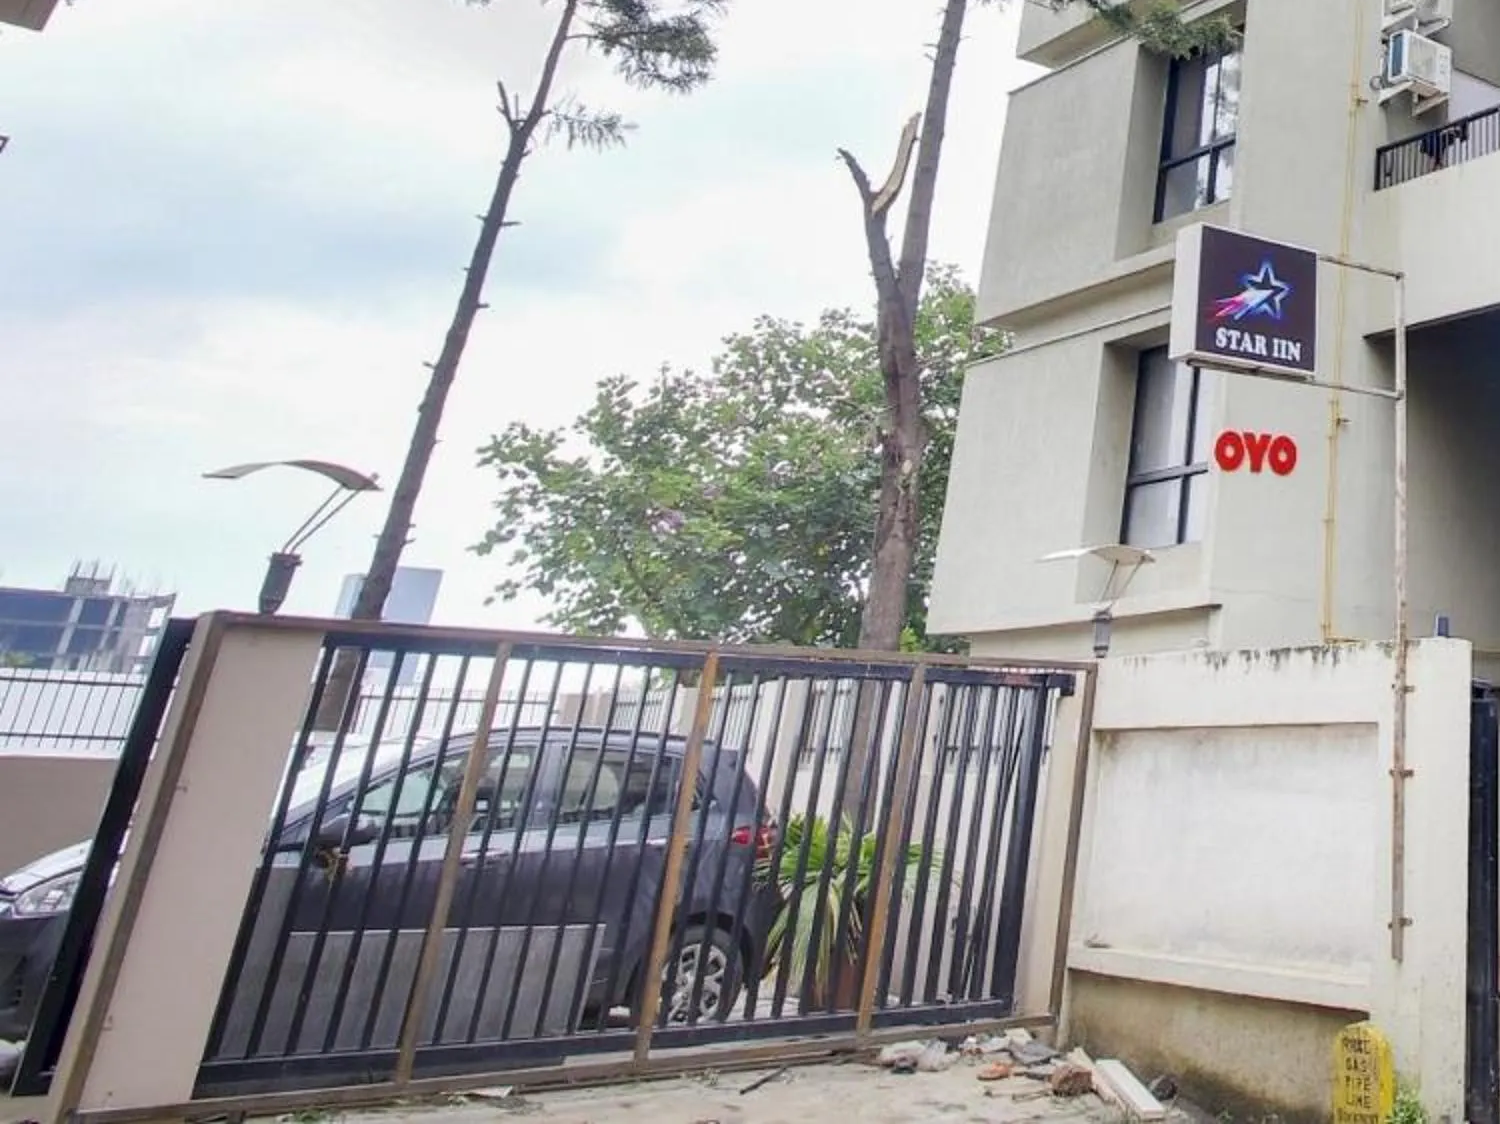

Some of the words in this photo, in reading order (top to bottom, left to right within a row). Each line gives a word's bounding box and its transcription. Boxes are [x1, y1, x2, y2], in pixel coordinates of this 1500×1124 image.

[1215, 327, 1268, 356] STAR
[1272, 337, 1301, 362] IIN
[1214, 431, 1297, 476] OYO
